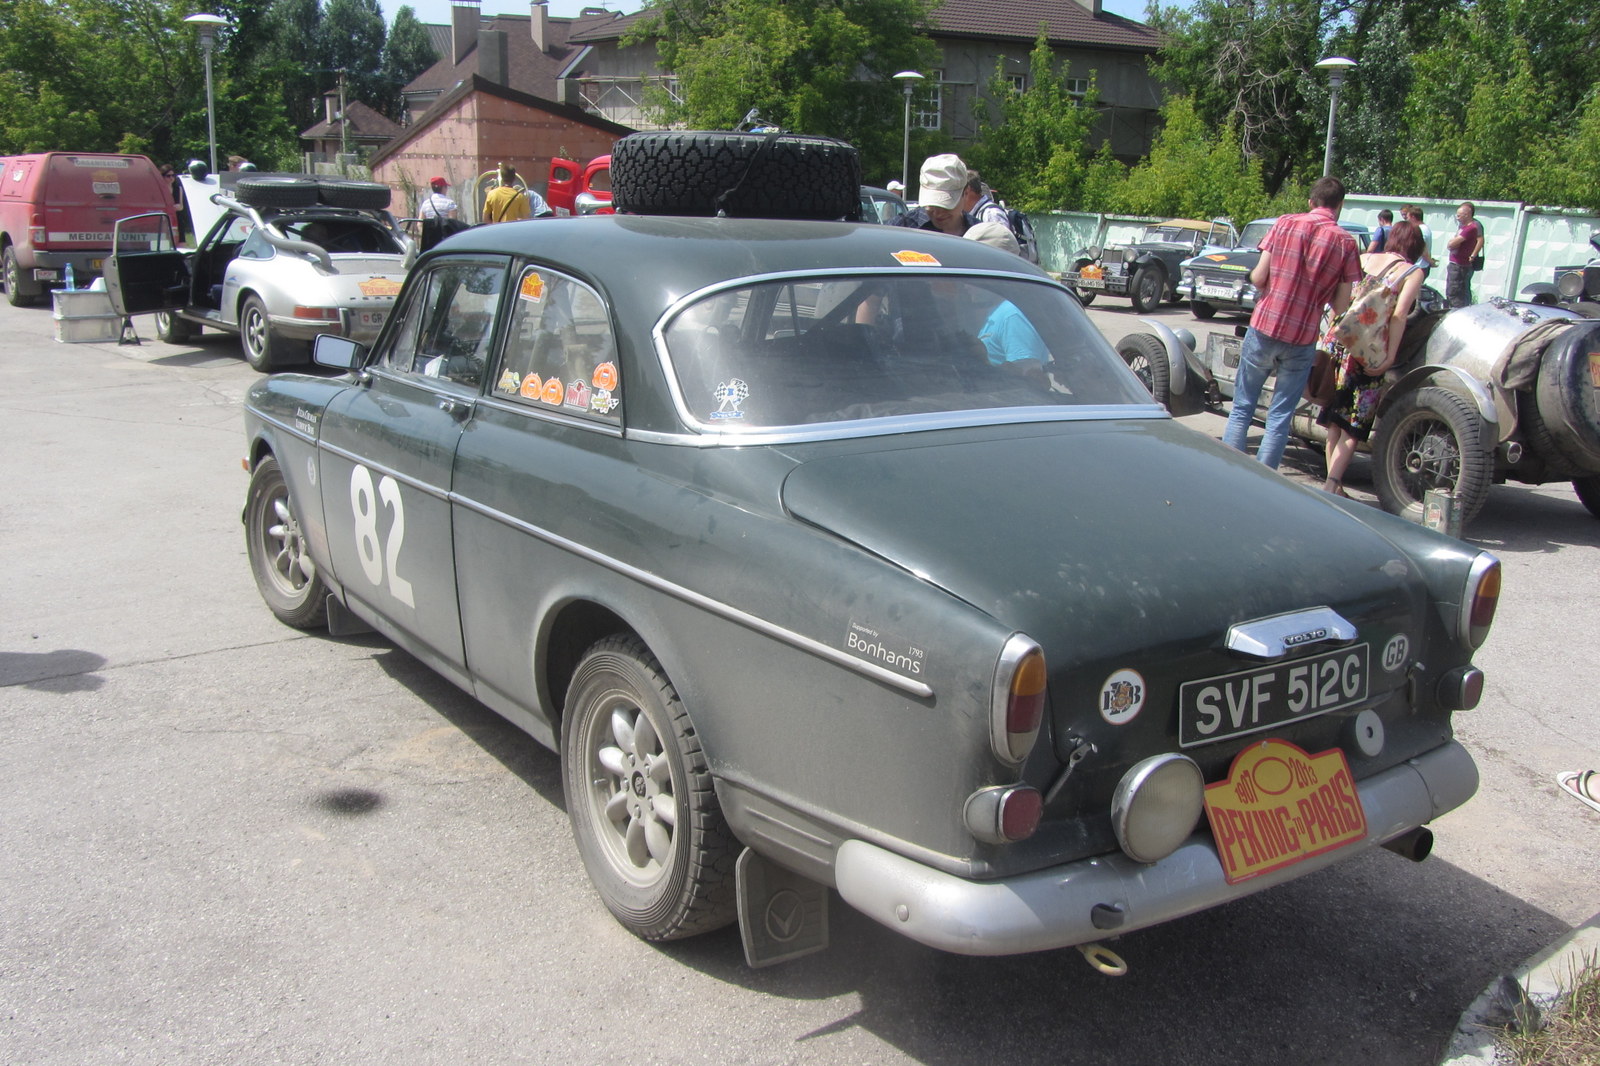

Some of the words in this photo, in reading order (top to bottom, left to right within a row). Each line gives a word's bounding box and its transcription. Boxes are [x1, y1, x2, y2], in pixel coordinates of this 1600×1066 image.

[69, 233, 115, 241] MEDICA
[121, 233, 147, 241] UNIT
[371, 313, 383, 323] GR
[351, 464, 415, 609] 82
[851, 622, 873, 635] Supported
[873, 630, 879, 638] by
[1284, 629, 1326, 645] VOLVO
[848, 632, 921, 674] Bonhams
[908, 646, 923, 659] 1793
[1386, 638, 1405, 667] GB
[1196, 672, 1275, 735] SVF
[1287, 653, 1360, 713] 512G
[1234, 769, 1259, 805] 1907
[1288, 756, 1319, 789] 2013
[1296, 768, 1362, 845] PARIS
[1210, 805, 1301, 872] PEKING
[1292, 816, 1305, 835] TO
